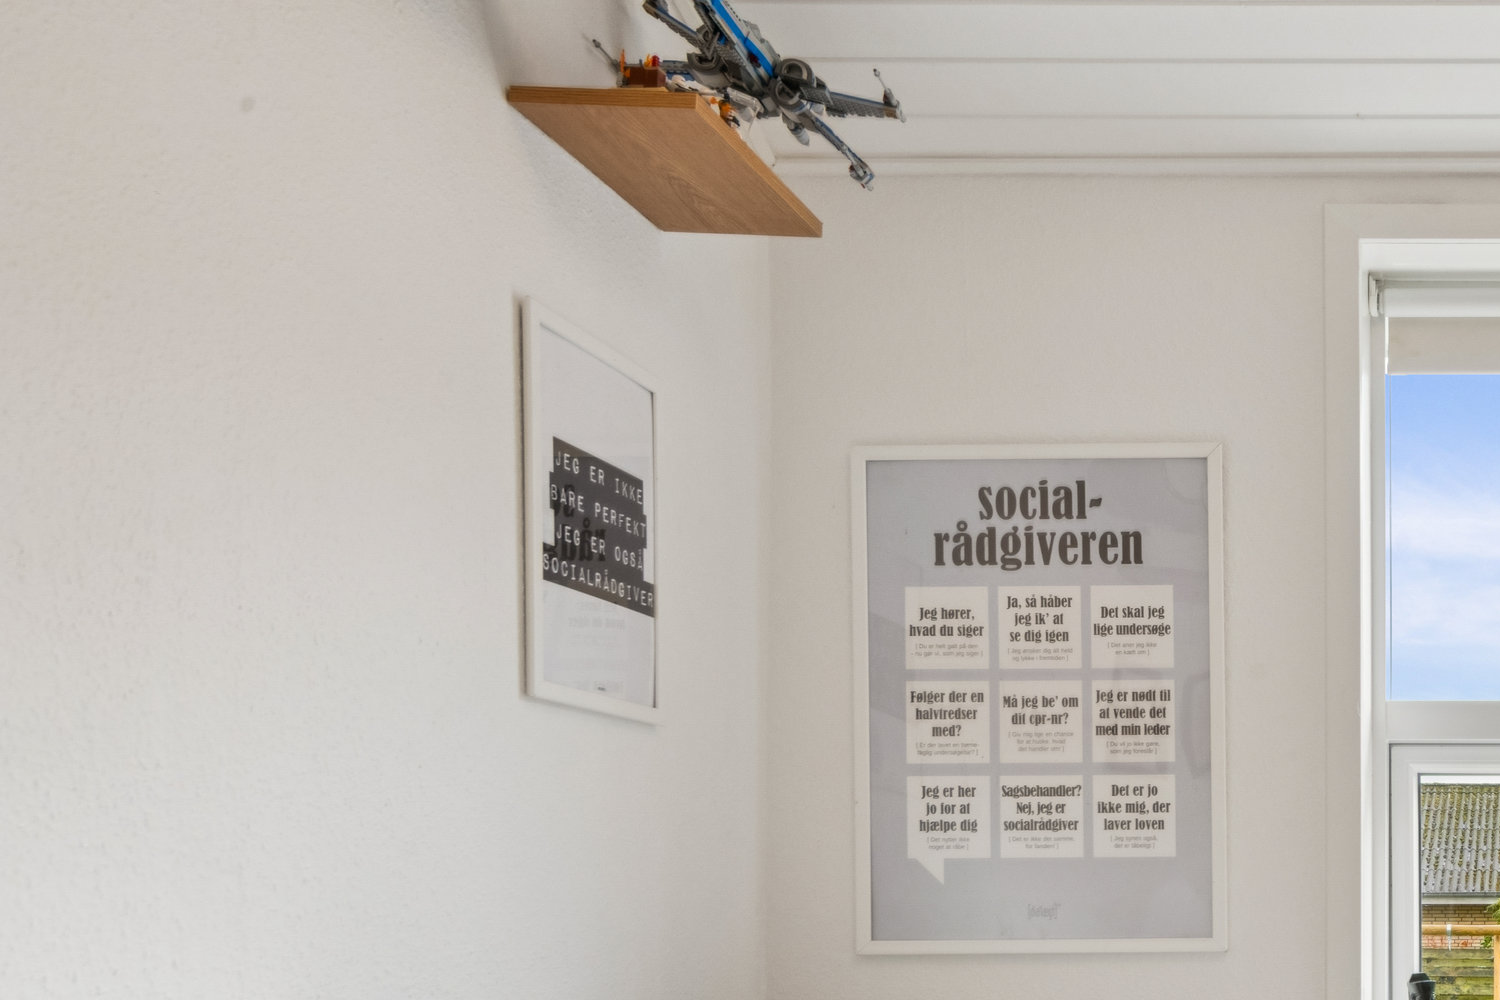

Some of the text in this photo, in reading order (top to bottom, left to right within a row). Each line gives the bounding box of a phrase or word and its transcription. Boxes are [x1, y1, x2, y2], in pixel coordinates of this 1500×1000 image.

[555, 451, 643, 505] JEG ER IKKE
[978, 479, 1102, 521] social-
[550, 484, 584, 512] BARE
[594, 502, 646, 538] PERFEKT
[556, 524, 643, 569] JEG ER OGSÅ
[934, 521, 1143, 571] rådgiveren
[543, 553, 654, 608] SOCIALRÅDGIVER
[1007, 594, 1072, 609] Ja, så håber
[919, 608, 974, 621] Jeg hører,
[1015, 613, 1063, 626] jeg at
[1101, 606, 1165, 619] Det skal jeg
[909, 624, 984, 638] hvad du siger
[1010, 630, 1069, 643] se dig igen
[1093, 623, 1171, 637] lige undersøge
[911, 691, 984, 704] Følger der en
[1003, 694, 1018, 708] Må
[1021, 696, 1038, 709] jeg
[1062, 697, 1078, 707] om
[1096, 689, 1171, 703] Jeg er nødt til
[915, 708, 977, 720] halvtredser
[1011, 713, 1068, 726] dit cpr-nr?
[1099, 706, 1166, 719] at vende det
[932, 725, 961, 737] med?
[1096, 724, 1170, 736] med min leder
[921, 785, 976, 799] Jeg er her
[1002, 785, 1081, 798] Sagsbehandler?
[1112, 784, 1158, 797] Det er jo
[926, 802, 970, 816] jo for at
[1016, 802, 1066, 815] Nej, jeg er
[1097, 801, 1171, 815] ikke mig, der
[919, 819, 978, 833] hjælpe dig
[1004, 817, 1079, 832] socialrådgiver
[1104, 818, 1165, 830] laver loven
